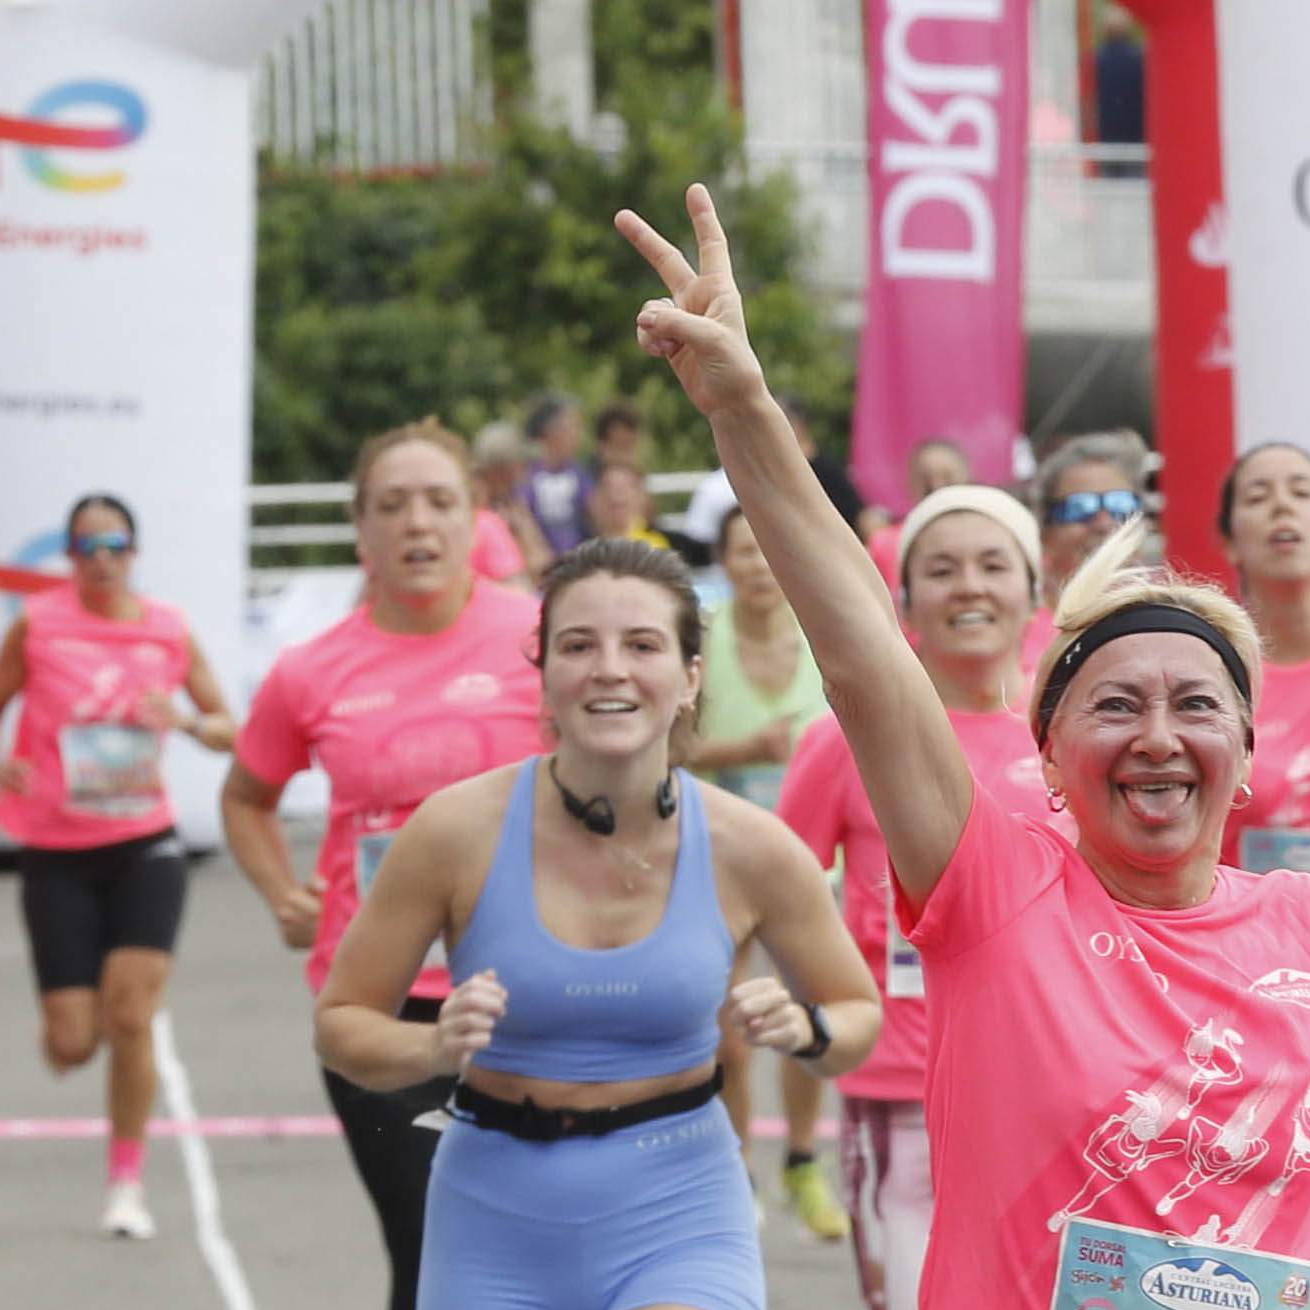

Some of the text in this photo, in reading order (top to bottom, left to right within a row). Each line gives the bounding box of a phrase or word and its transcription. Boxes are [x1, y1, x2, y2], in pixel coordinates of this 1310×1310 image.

[1078, 1246, 1124, 1268] SUMA
[1149, 1271, 1252, 1310] ASTURIANA
[1284, 1276, 1307, 1297] 20
